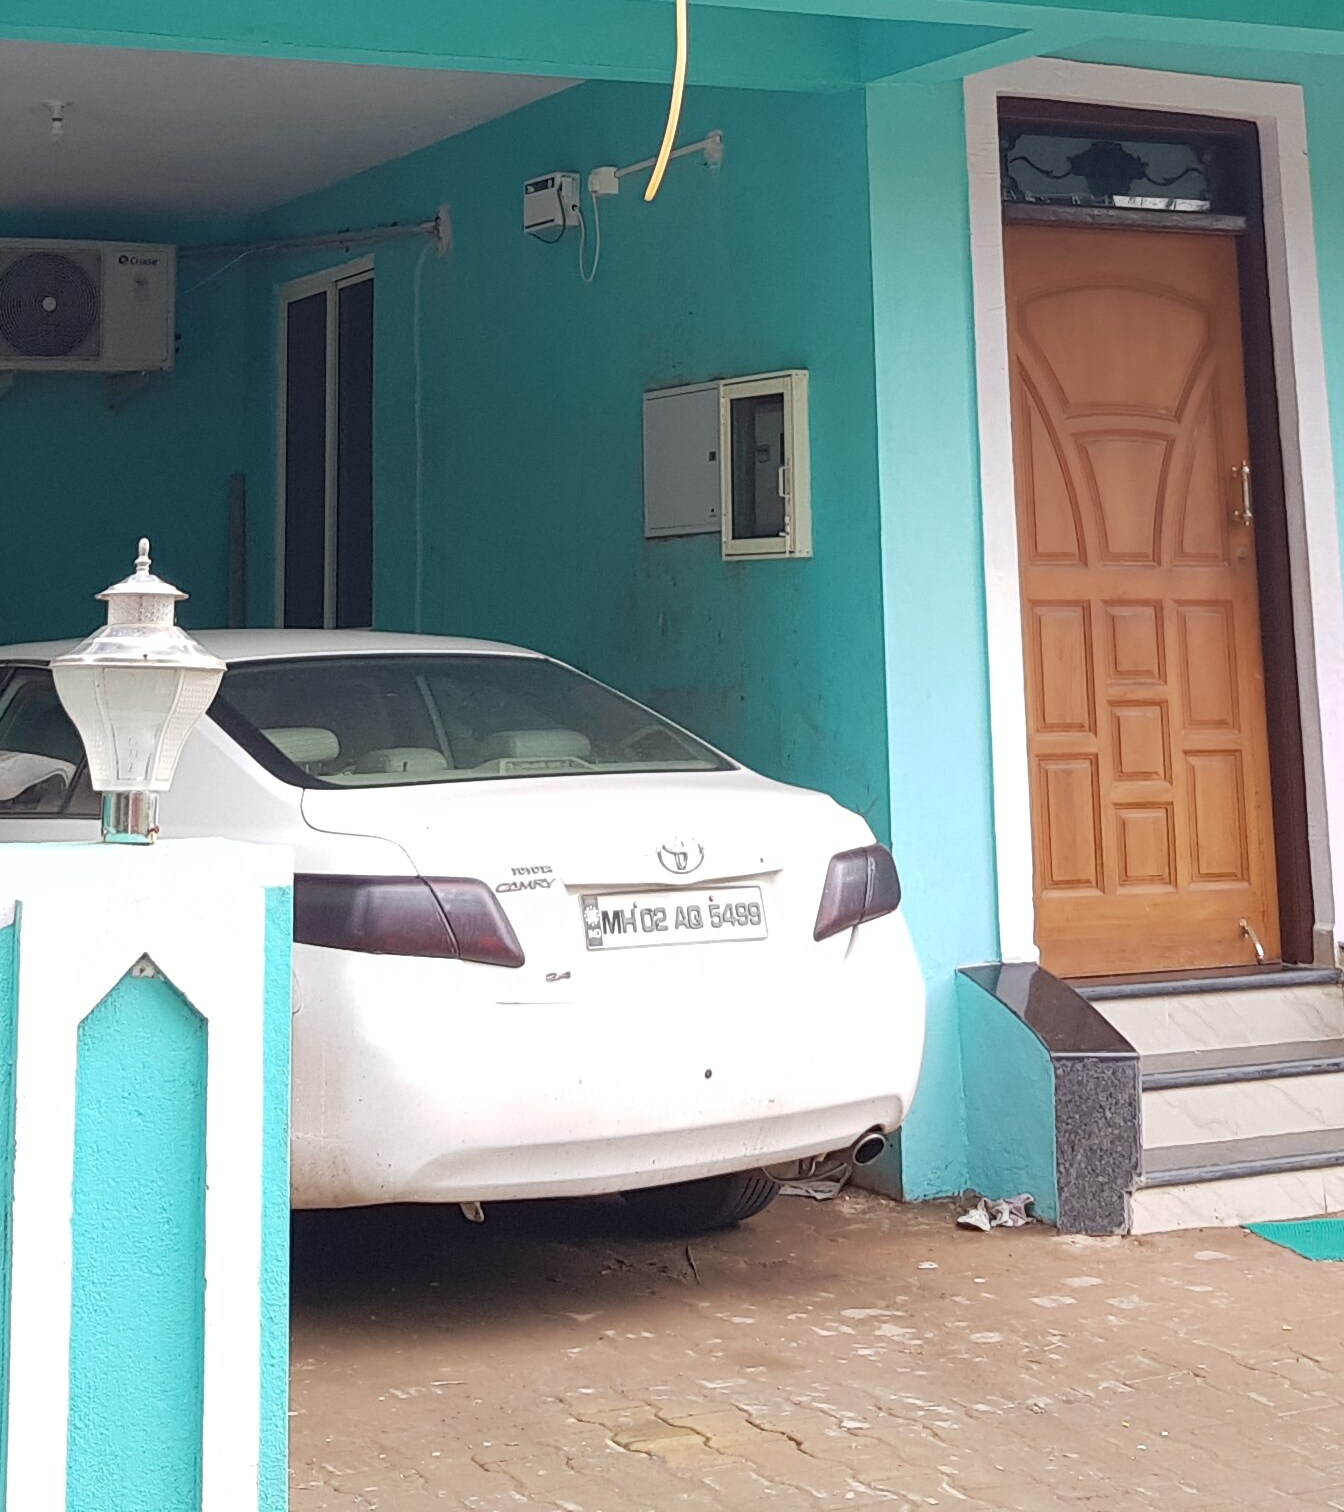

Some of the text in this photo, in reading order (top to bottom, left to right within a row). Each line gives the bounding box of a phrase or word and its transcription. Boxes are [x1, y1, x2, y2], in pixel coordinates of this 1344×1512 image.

[601, 907, 638, 936] MH
[639, 906, 670, 933] 02
[709, 902, 762, 929] 5499
